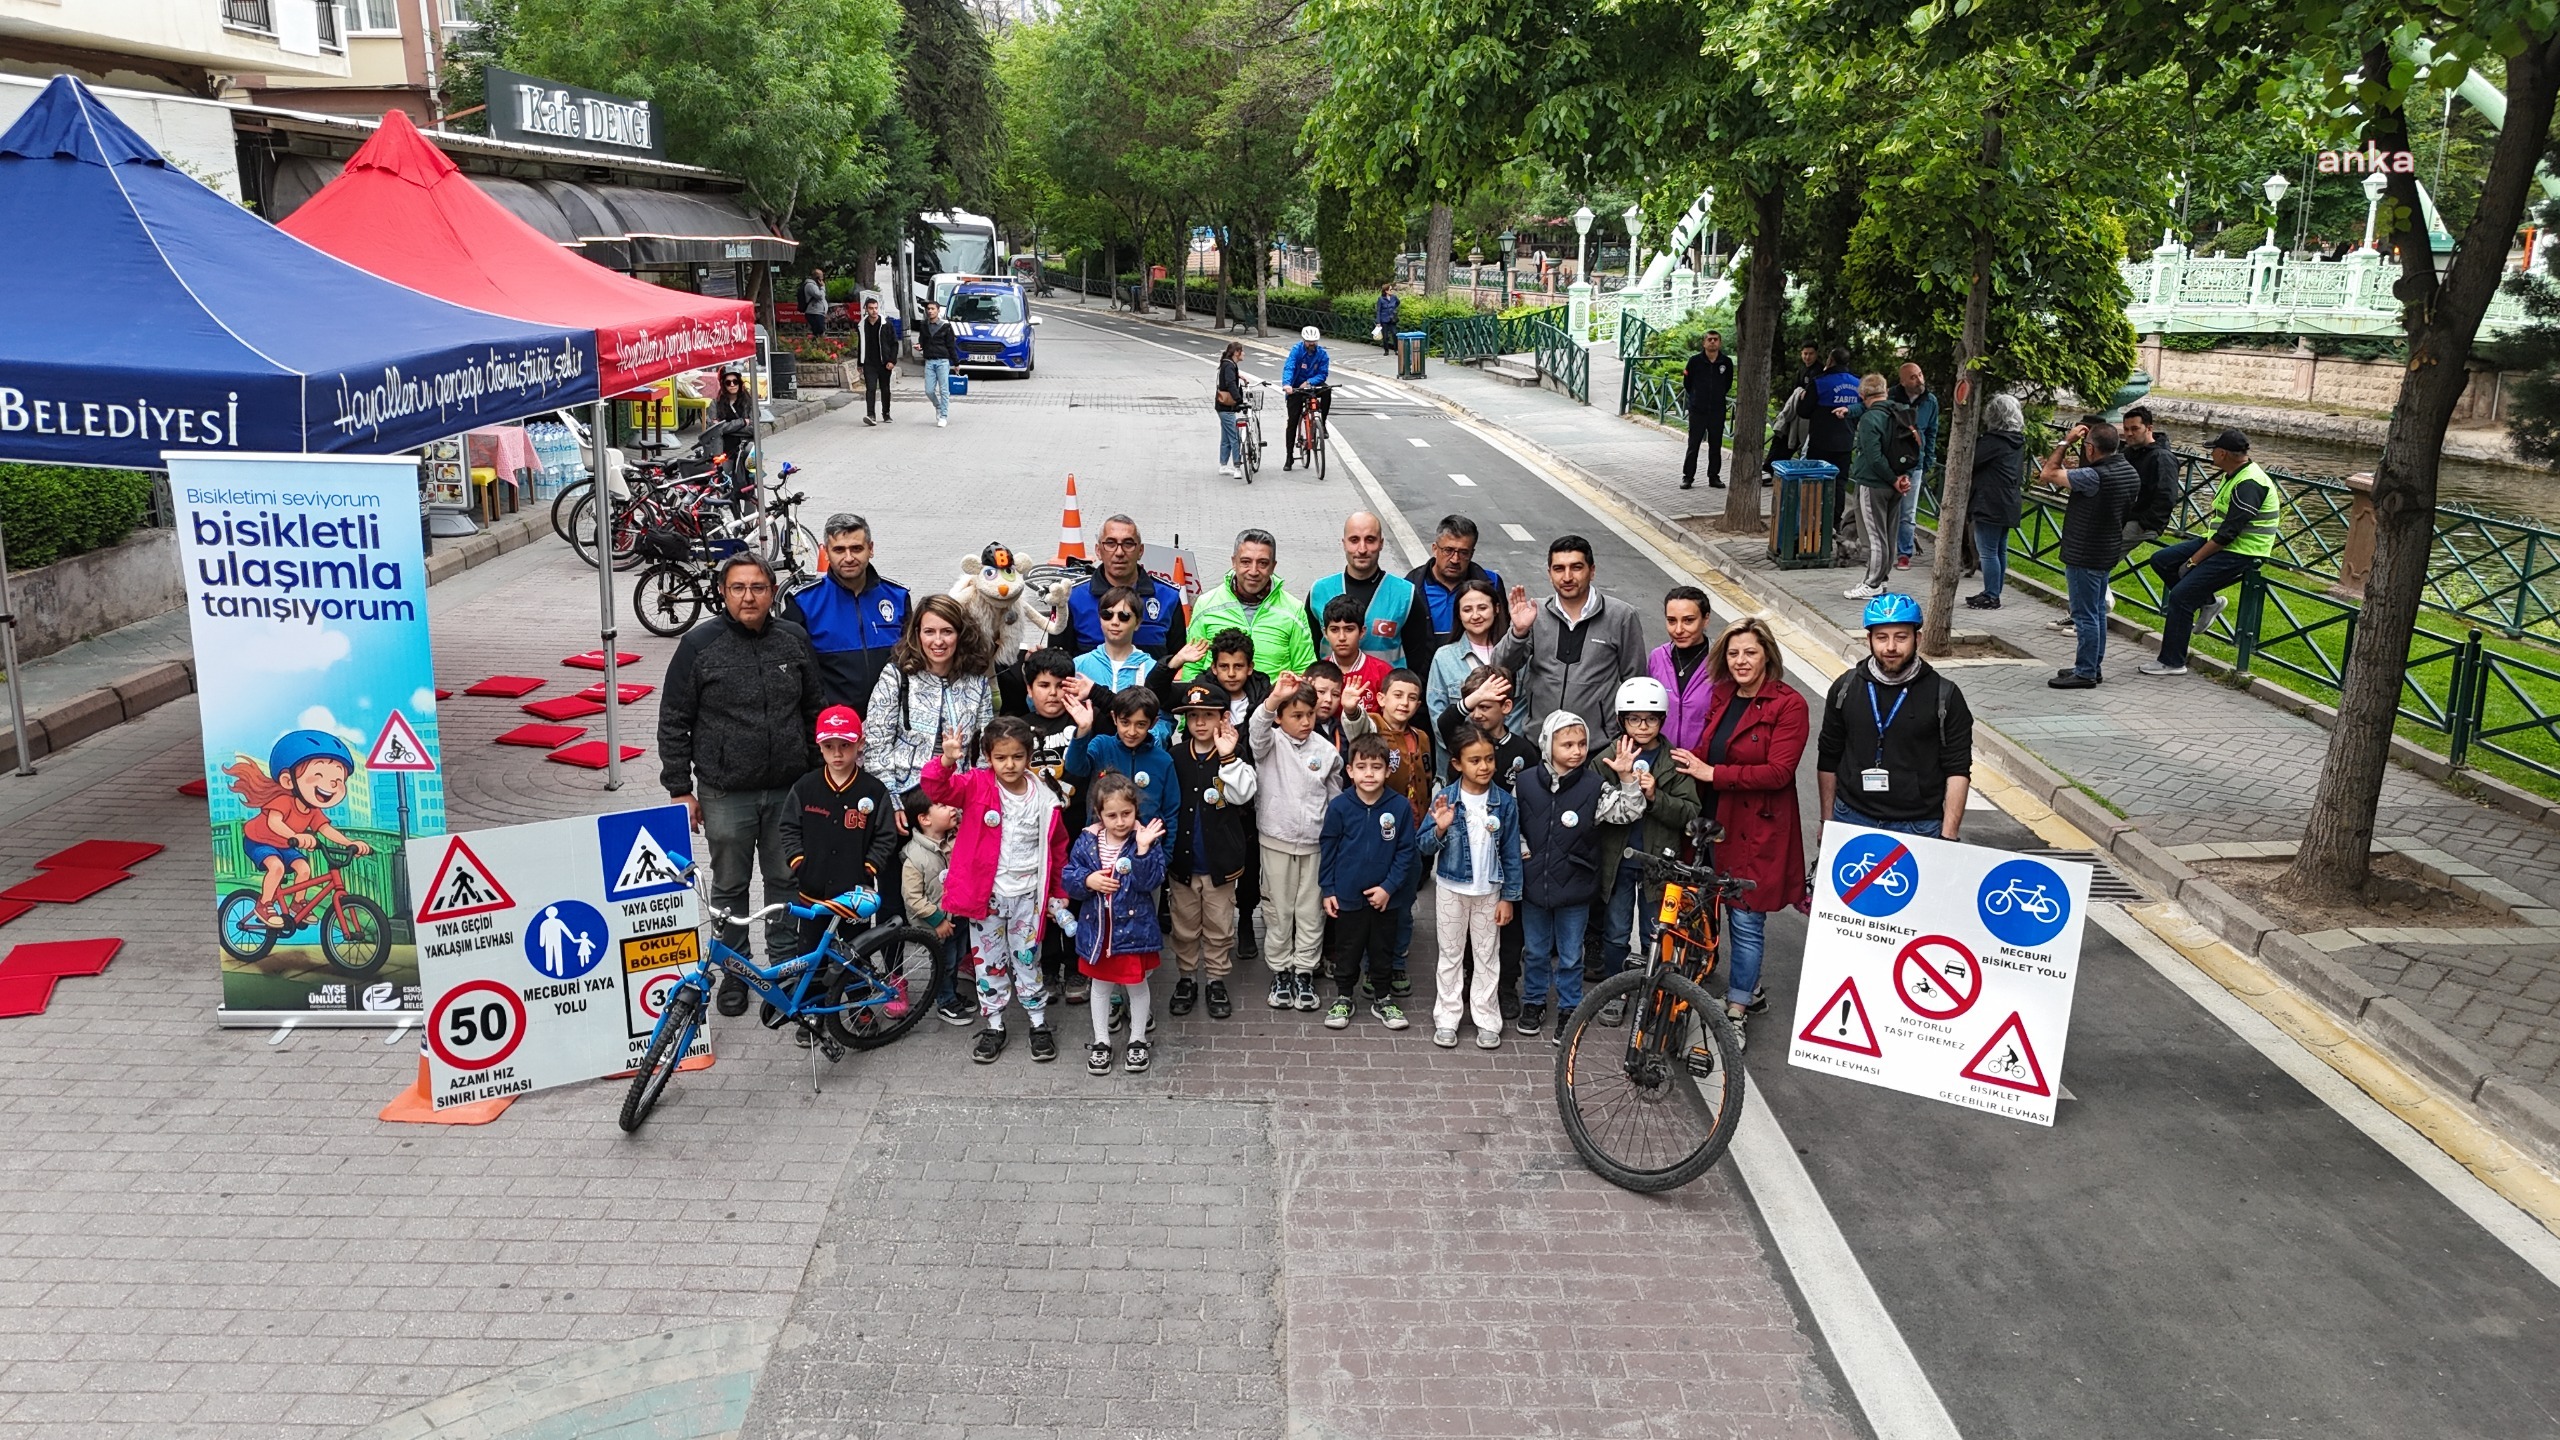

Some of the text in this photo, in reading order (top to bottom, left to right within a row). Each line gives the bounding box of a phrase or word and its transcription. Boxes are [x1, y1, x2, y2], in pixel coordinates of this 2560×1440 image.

[519, 84, 652, 149] Kafe DENGİ
[616, 328, 665, 381] Hayallerin
[334, 337, 584, 443] Hayallerin gerçeğe dönüştüğü şehir
[0, 387, 239, 446] BELEDİYESİ
[187, 488, 380, 509] Bisikletimi seviyorum
[192, 510, 380, 550] bisikletli
[995, 549, 1009, 568] B
[198, 551, 402, 593] ulaşımla
[201, 592, 415, 625] tanışıyorum
[622, 892, 684, 917] YAYA GEÇİDİ
[435, 914, 493, 937] YAYA GEÇİDİ
[632, 915, 677, 934] LEVHASI
[1818, 911, 1917, 937] MECBURİ BİSİKLET
[424, 931, 514, 959] YAKLAŞIM LEVHASI
[640, 937, 680, 952] OKUL
[1836, 927, 1896, 946] YOLU SONU
[630, 946, 692, 969] BÖLGESİ
[2000, 946, 2052, 963] MECBURİ
[1982, 956, 2067, 980] BİSİKLET YOLU
[308, 992, 347, 1004] ÜNLÜCE
[321, 984, 347, 995] AYŞE
[403, 985, 422, 993] ESKİŞ
[403, 993, 423, 1001] BÜYÜ
[523, 977, 615, 1002] MECBURİ YAYA
[554, 999, 587, 1015] YOLU
[450, 1002, 507, 1046] 50
[1884, 1025, 1914, 1039] TAŞIT
[1900, 1016, 1952, 1034] MOTORLU
[629, 1039, 650, 1052] OKU
[1794, 1049, 1880, 1076] DİKKAT LEVHASI
[450, 1066, 515, 1090] AZAMİ HIZ
[437, 1079, 532, 1108] SINIRI LEVHASI
[2000, 1105, 2050, 1123] LEVHASI
